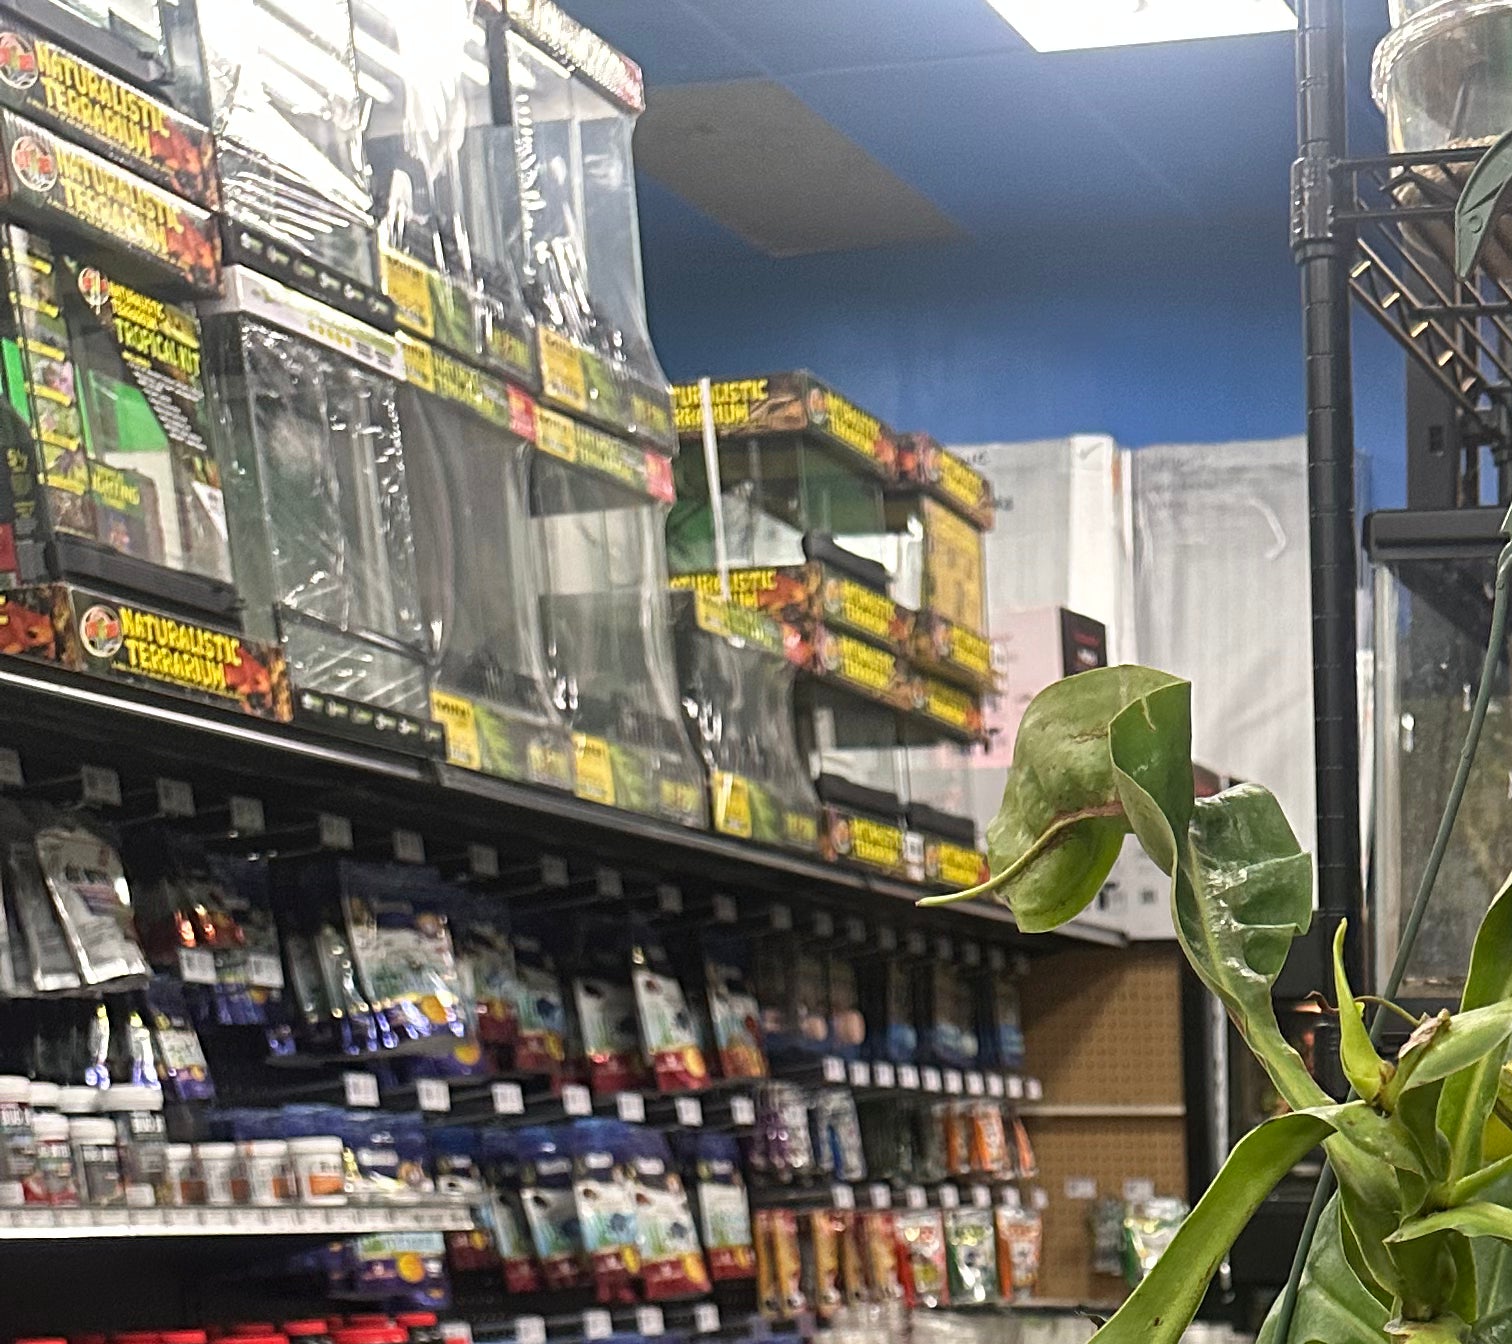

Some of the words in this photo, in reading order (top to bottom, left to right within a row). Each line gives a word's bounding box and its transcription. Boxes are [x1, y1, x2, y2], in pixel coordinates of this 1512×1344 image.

[33, 39, 171, 138] NATURALISTIC
[40, 76, 152, 159] TERRARIUM
[119, 606, 242, 667] NATURALISTIC
[123, 638, 227, 690] TERRARIUM
